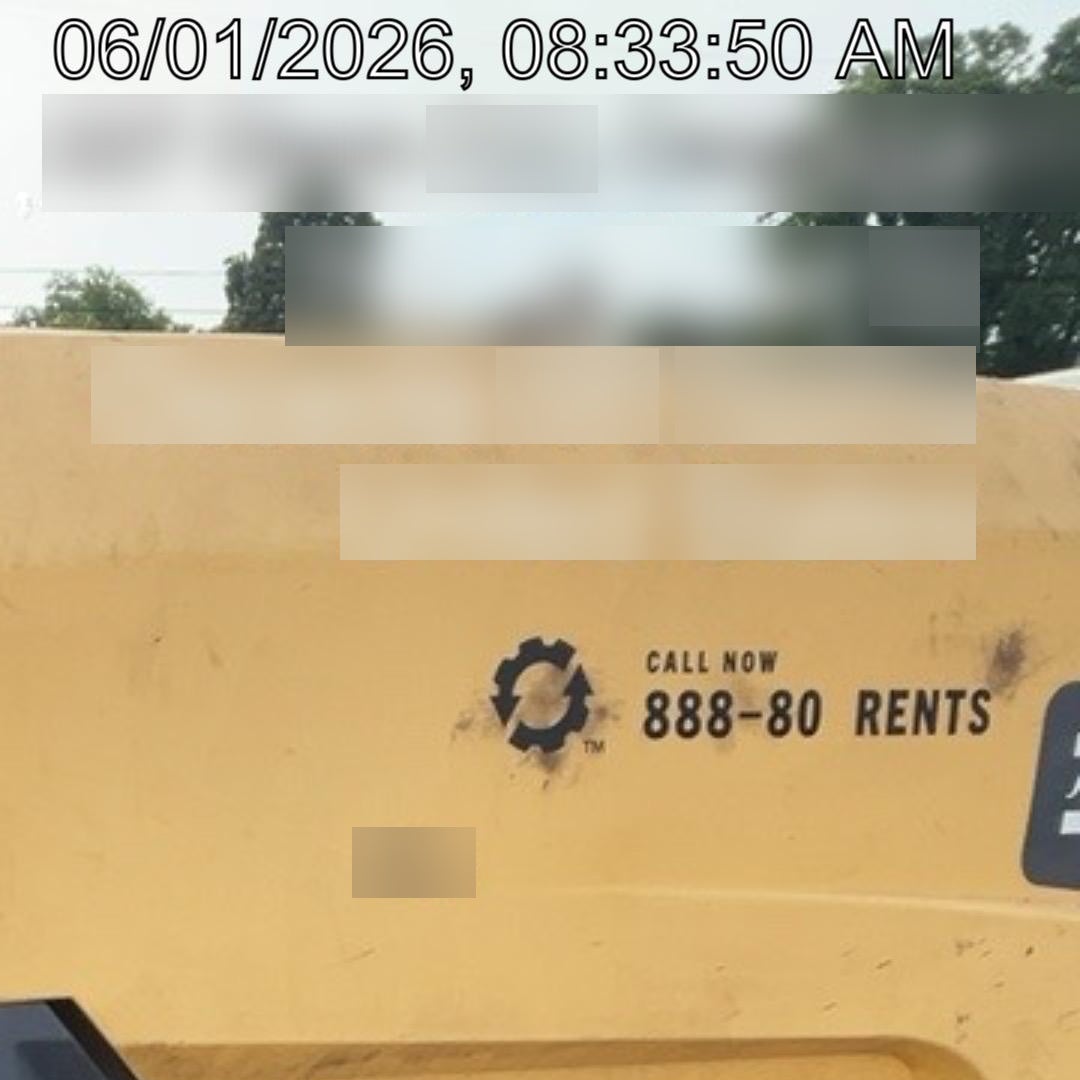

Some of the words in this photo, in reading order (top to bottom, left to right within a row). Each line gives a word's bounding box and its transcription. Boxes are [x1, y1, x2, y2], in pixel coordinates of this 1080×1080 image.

[646, 650, 710, 674] CALL
[723, 650, 779, 673] NOW
[644, 688, 823, 740] 888-80
[854, 688, 992, 736] RENTS
